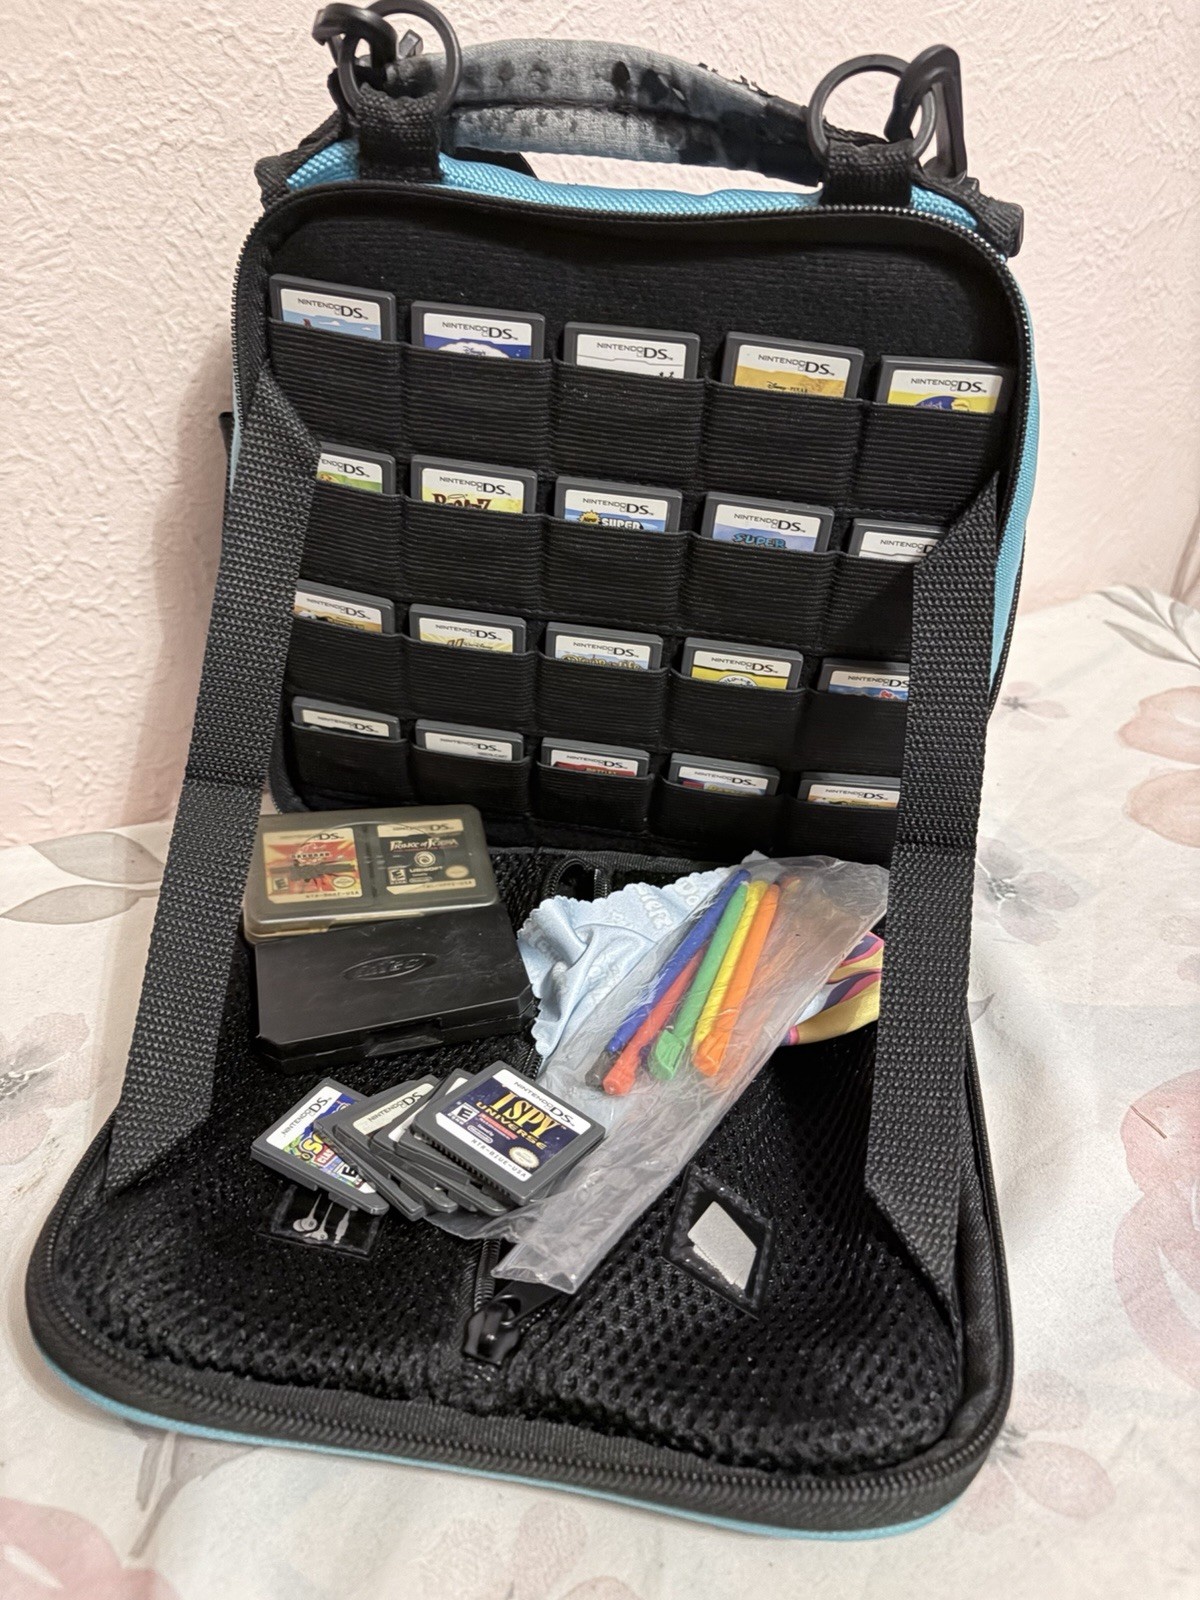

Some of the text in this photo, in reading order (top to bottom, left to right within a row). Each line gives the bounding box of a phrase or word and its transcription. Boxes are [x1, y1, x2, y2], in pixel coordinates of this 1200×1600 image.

[298, 298, 363, 319] NINTENDO DS
[442, 321, 513, 340] NINTENDO DS
[597, 342, 668, 360] NINTENDO DS
[758, 354, 830, 375] NINTENDO DS
[911, 378, 983, 393] NINTENDO DS
[344, 464, 365, 476] DS
[440, 476, 506, 495] NINTENDO DS
[583, 498, 649, 515] NINTENDO DS
[601, 517, 641, 530] SUPER
[734, 513, 802, 532] NINTENDO DS
[733, 532, 787, 549] SUPER
[346, 607, 367, 619] DS
[476, 630, 497, 640] DS
[573, 642, 635, 657] NINTENDO DS
[711, 657, 774, 673] NINTENDO DS
[354, 723, 375, 732] DS
[478, 743, 497, 752] DS
[604, 760, 624, 769] DS
[732, 777, 753, 786] DS
[864, 792, 885, 800] DS
[429, 823, 449, 831] DS
[319, 832, 339, 841] DS
[368, 1092, 423, 1122] NINTENDO DS
[489, 1092, 518, 1111] I
[514, 1081, 575, 1125] NINTENDO DS
[281, 1097, 329, 1136] NINTENDO DS
[503, 1099, 561, 1138] SPY
[475, 1101, 548, 1150] UNIVERSE
